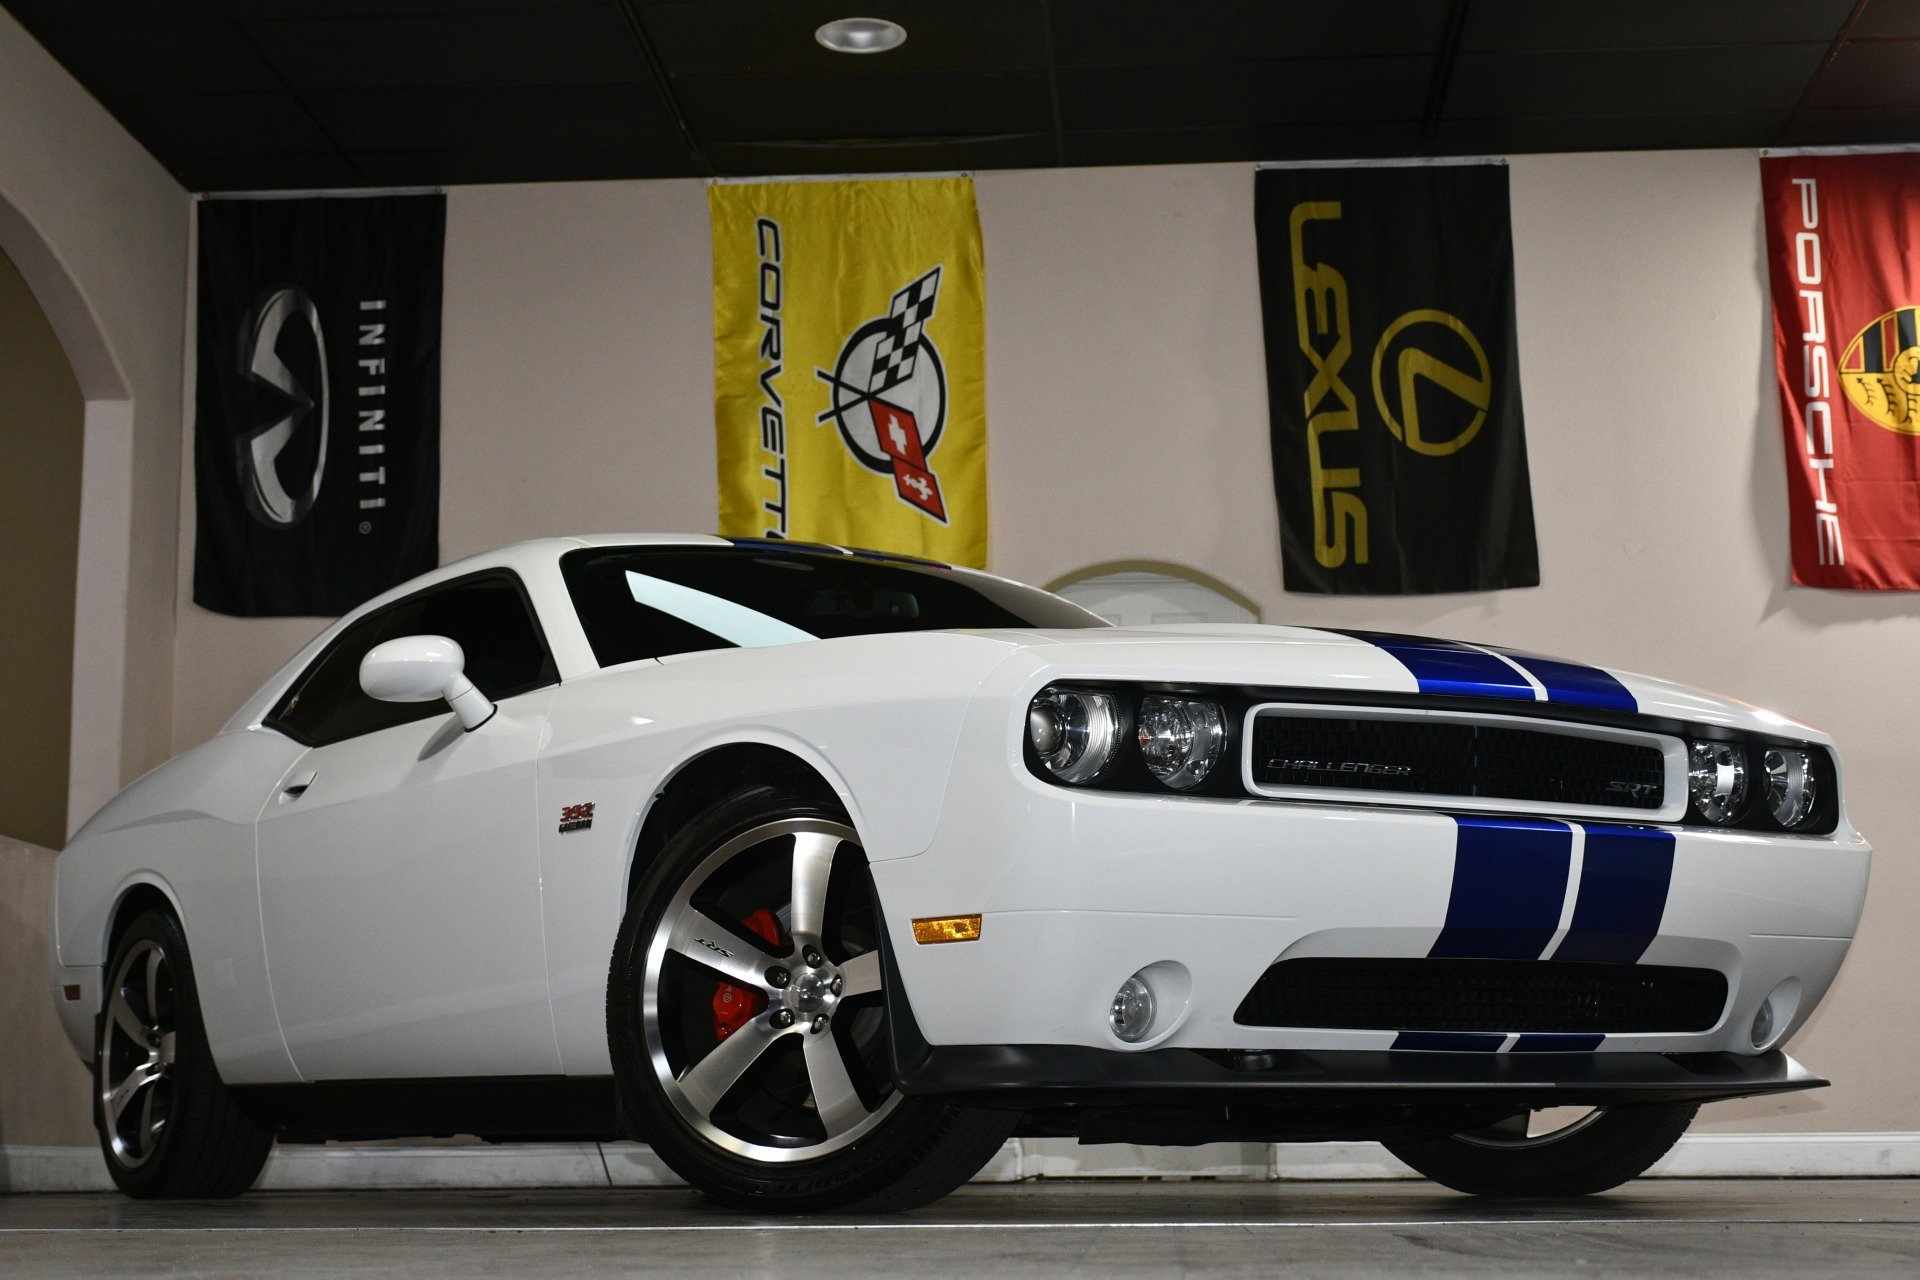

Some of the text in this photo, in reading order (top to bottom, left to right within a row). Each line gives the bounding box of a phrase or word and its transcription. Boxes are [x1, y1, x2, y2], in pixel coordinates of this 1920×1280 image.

[358, 300, 387, 509] INFINITI
[1289, 200, 1369, 569] LEXUS
[1791, 177, 1845, 567] PORSCHE
[1267, 757, 1412, 777] CHALLENGER
[1604, 780, 1659, 799] SRT
[693, 936, 735, 958] SRT
